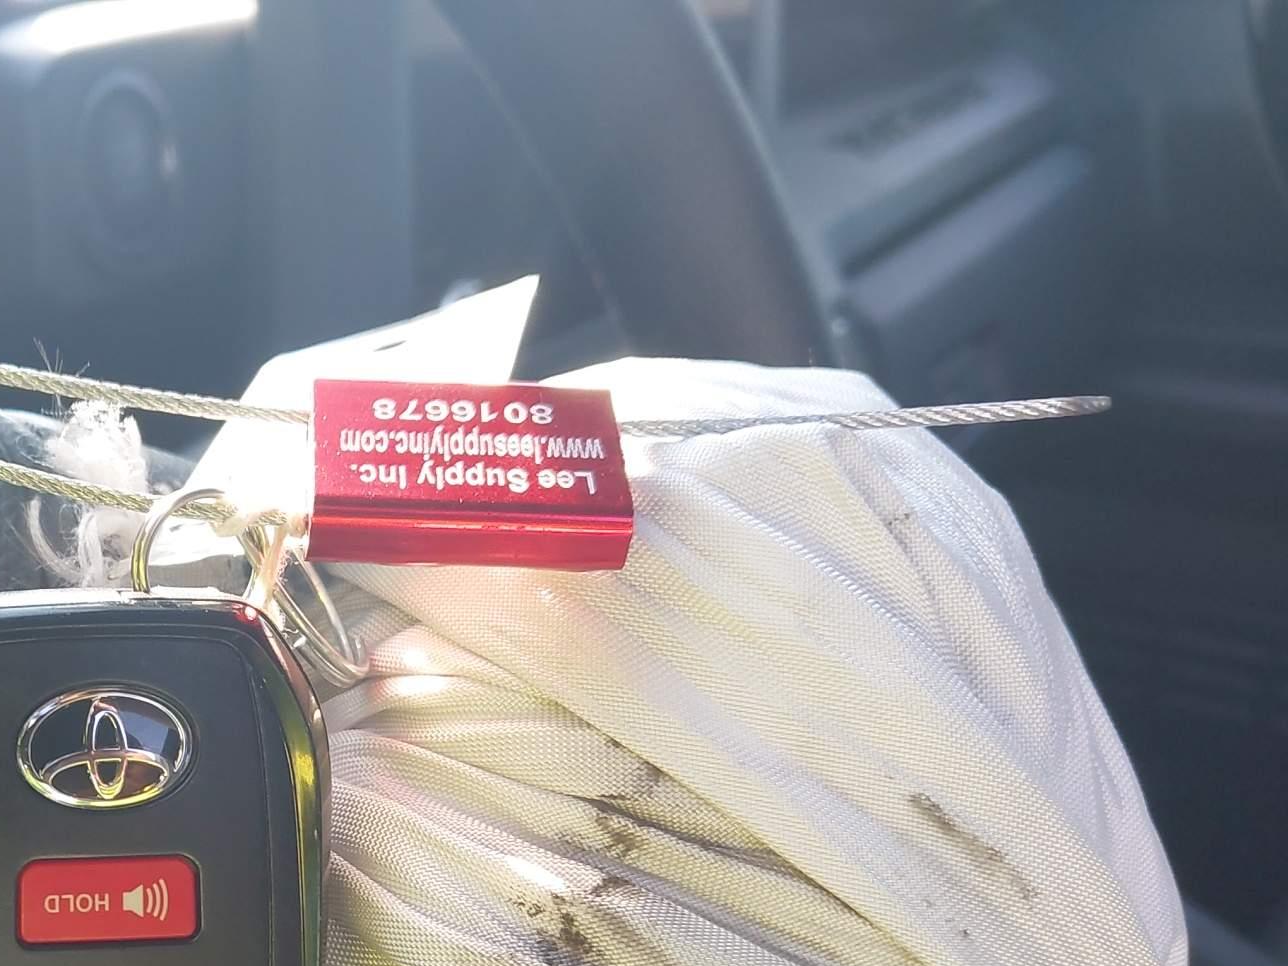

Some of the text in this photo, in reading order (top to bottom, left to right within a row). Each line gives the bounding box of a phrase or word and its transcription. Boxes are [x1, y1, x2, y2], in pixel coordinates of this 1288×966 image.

[372, 398, 554, 424] 8016678
[340, 426, 605, 464] www.leesupplyinc.com
[349, 460, 597, 495] Lee Supply Inc.
[44, 894, 110, 914] HOLD
